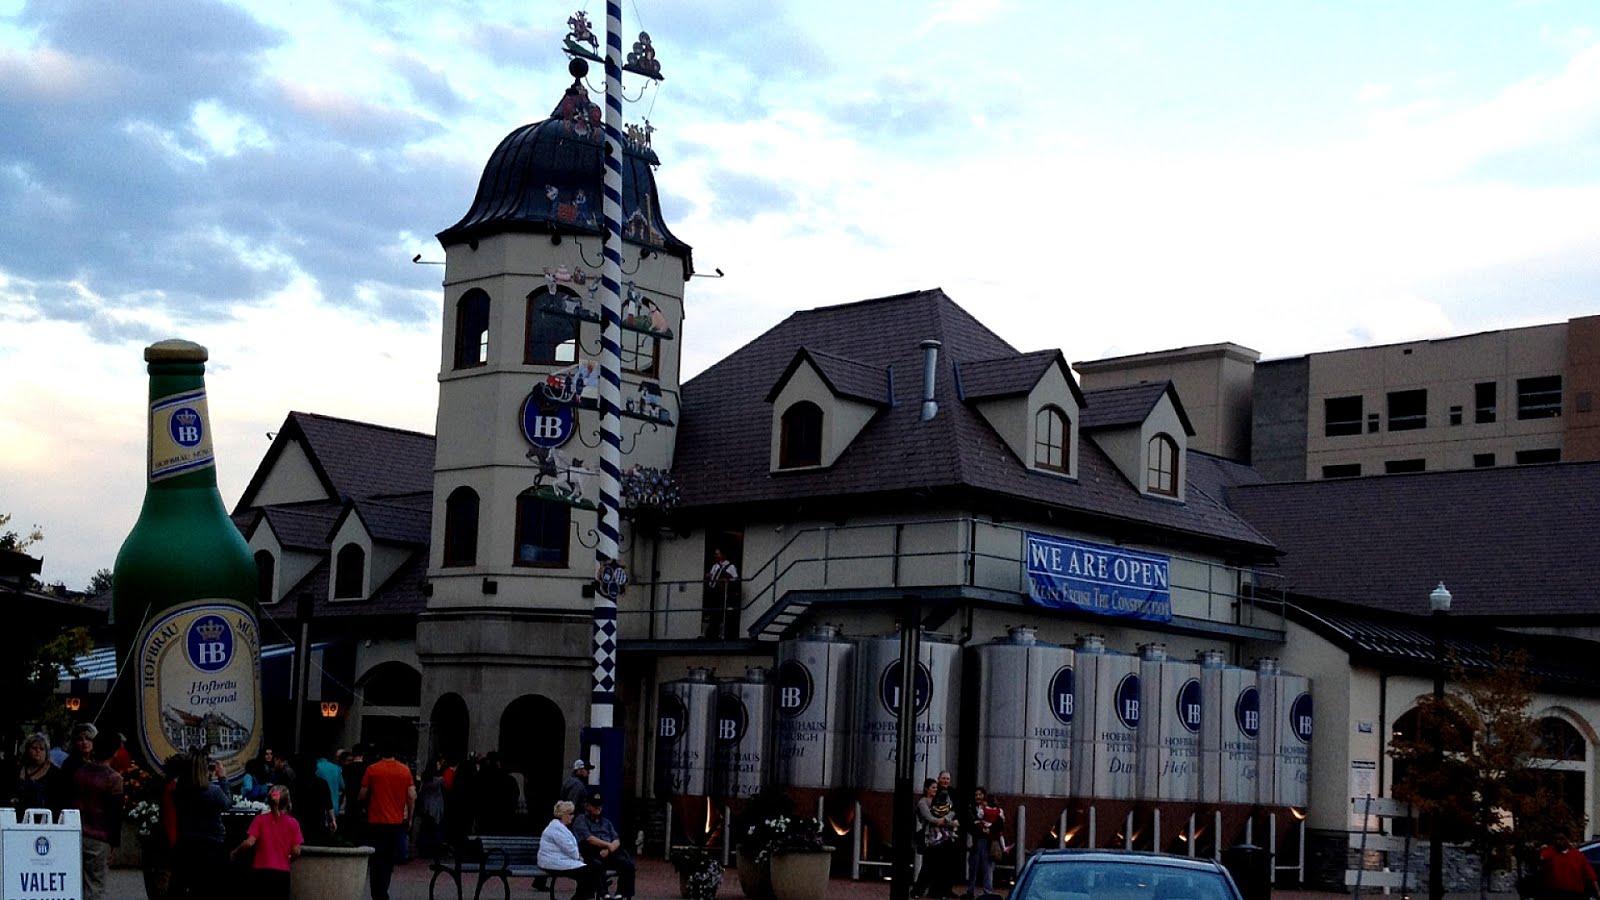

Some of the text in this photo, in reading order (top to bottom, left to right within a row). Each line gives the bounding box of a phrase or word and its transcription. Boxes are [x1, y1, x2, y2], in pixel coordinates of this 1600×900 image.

[178, 426, 199, 442] HB
[533, 415, 563, 438] HB
[1031, 543, 1167, 588] WE ARE OPEN
[198, 642, 226, 664] HB
[187, 679, 237, 695] Hofbräu
[190, 692, 237, 707] Original
[781, 687, 801, 708] HB
[1058, 693, 1073, 715] HB
[1124, 699, 1139, 720] HB
[1186, 704, 1201, 724] HB
[660, 718, 676, 737] HB
[719, 719, 737, 740] HB
[1244, 710, 1259, 730] HB
[1299, 715, 1313, 735] HB
[20, 872, 67, 892] VALET
